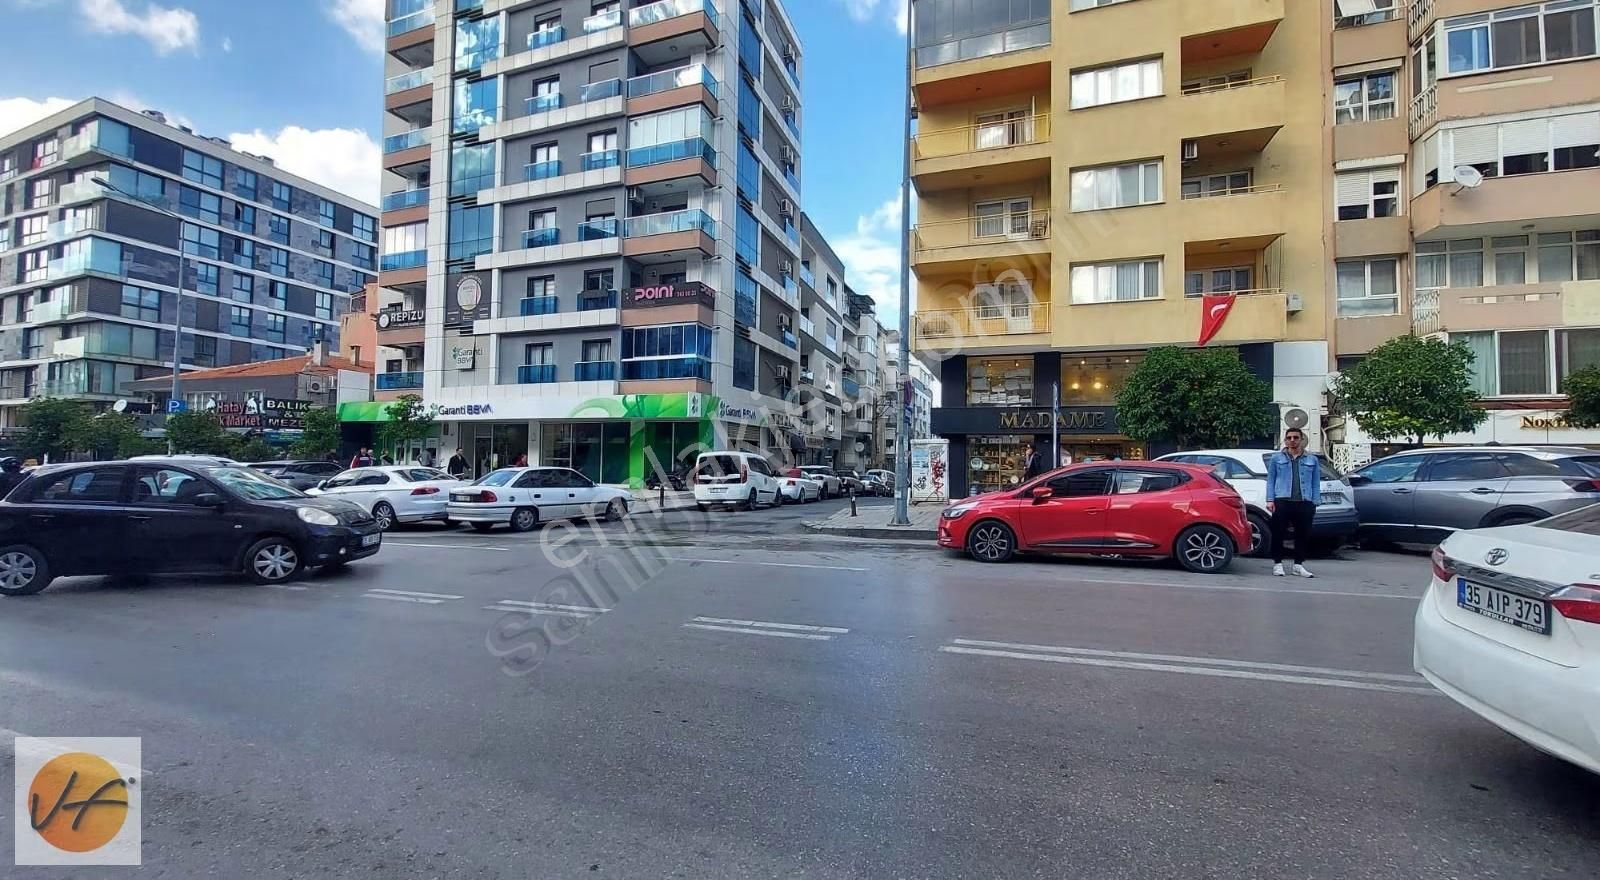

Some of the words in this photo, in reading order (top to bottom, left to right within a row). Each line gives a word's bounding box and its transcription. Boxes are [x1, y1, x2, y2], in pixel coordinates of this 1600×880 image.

[169, 400, 180, 412] P
[217, 402, 245, 415] Hatay
[266, 400, 308, 411] BALIK
[438, 404, 466, 416] Garanti
[467, 403, 492, 415] BBVA
[227, 415, 261, 427] Market
[999, 411, 1107, 429] MADAME
[1466, 584, 1481, 605] 35
[1486, 590, 1510, 614] AIP
[1515, 598, 1542, 624] 379
